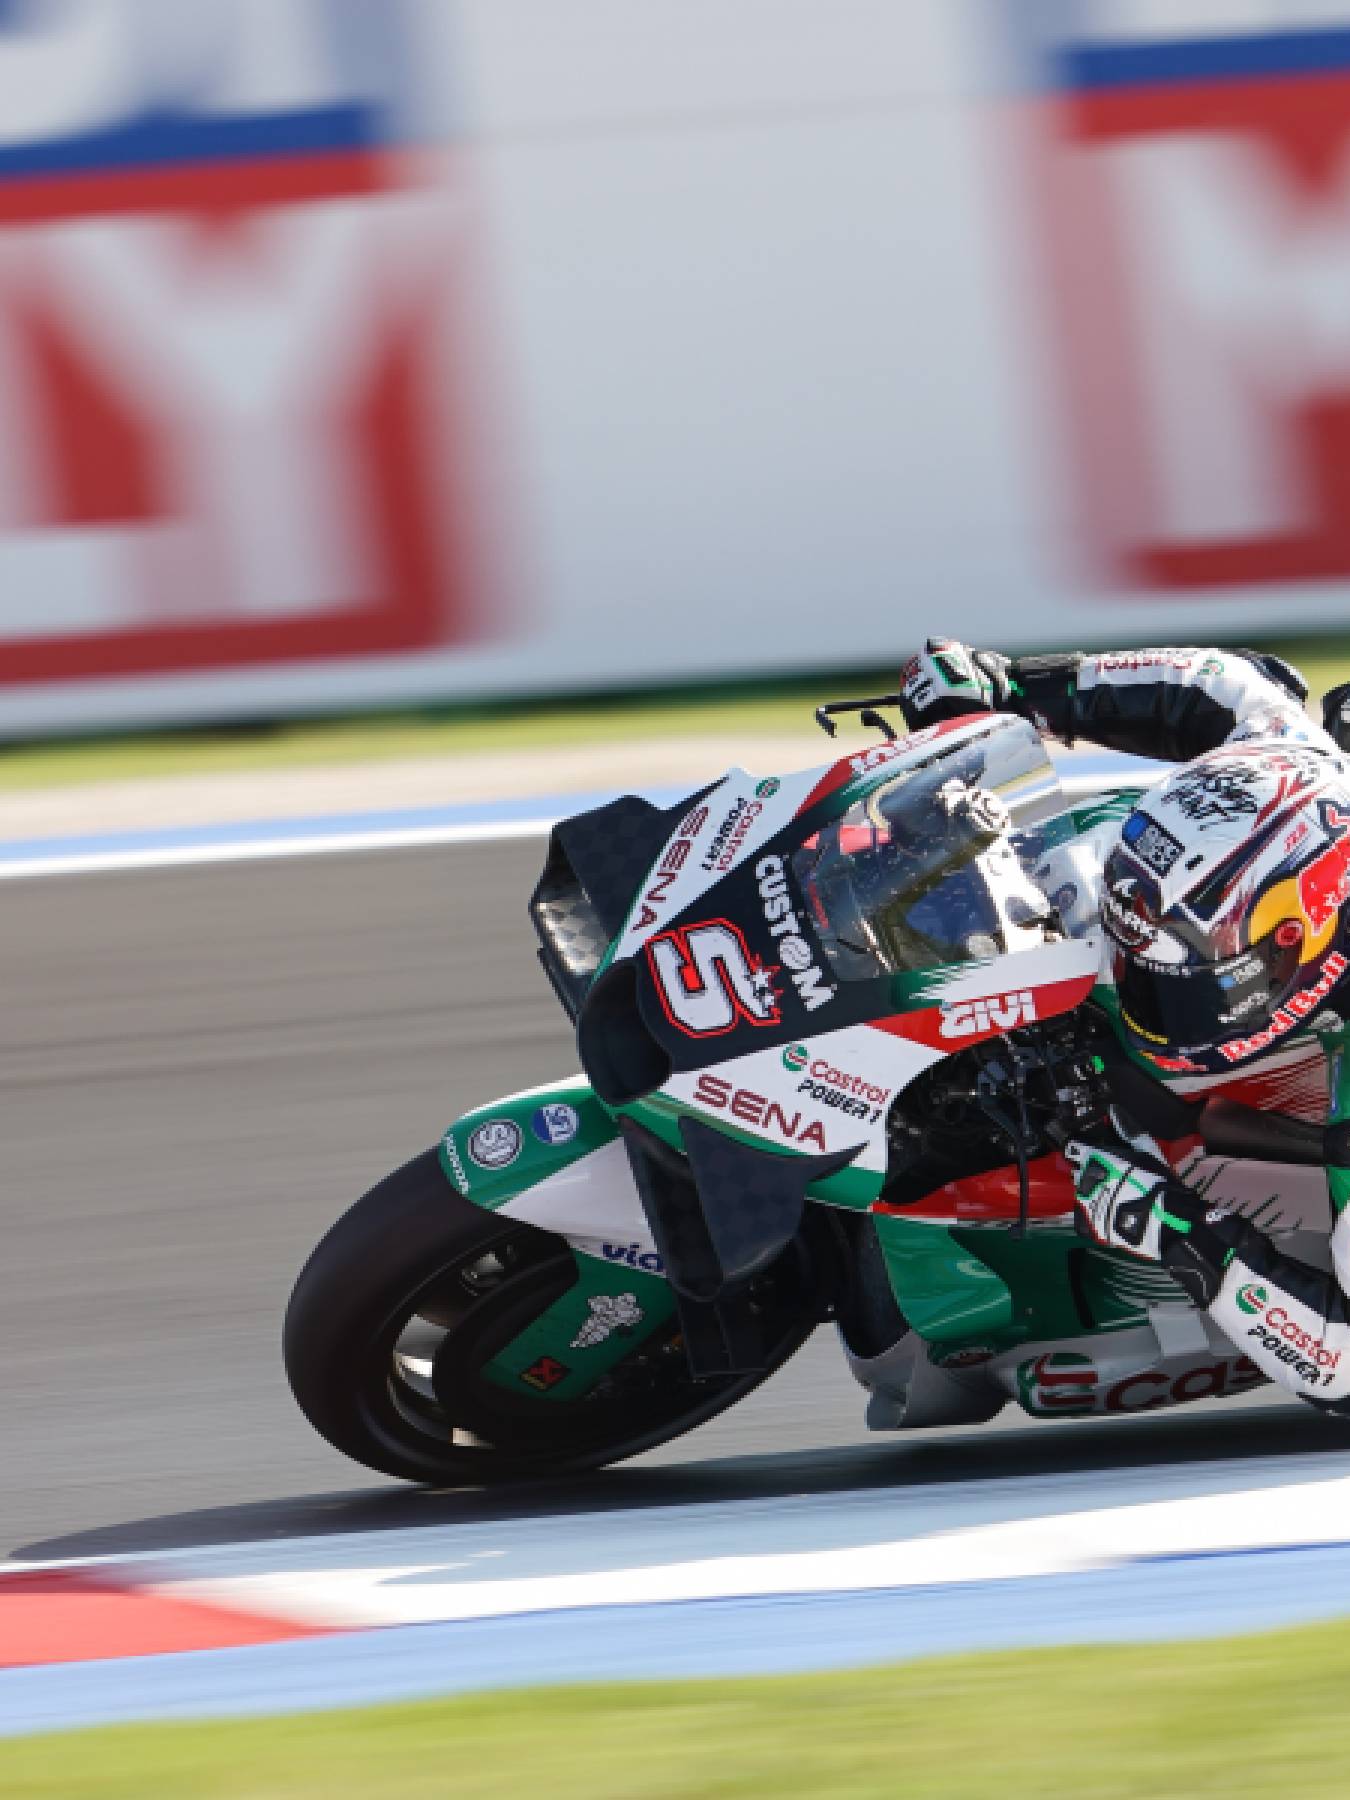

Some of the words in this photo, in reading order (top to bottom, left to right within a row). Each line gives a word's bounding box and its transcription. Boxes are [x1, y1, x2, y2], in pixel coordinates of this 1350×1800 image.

[633, 805, 709, 931] SENA
[645, 918, 780, 1038] 5
[1217, 1011, 1295, 1063] Red
[1285, 951, 1350, 1017] Bull
[693, 1074, 826, 1152] SENA
[807, 1058, 891, 1105] Castrol
[1265, 1307, 1342, 1370] Castol
